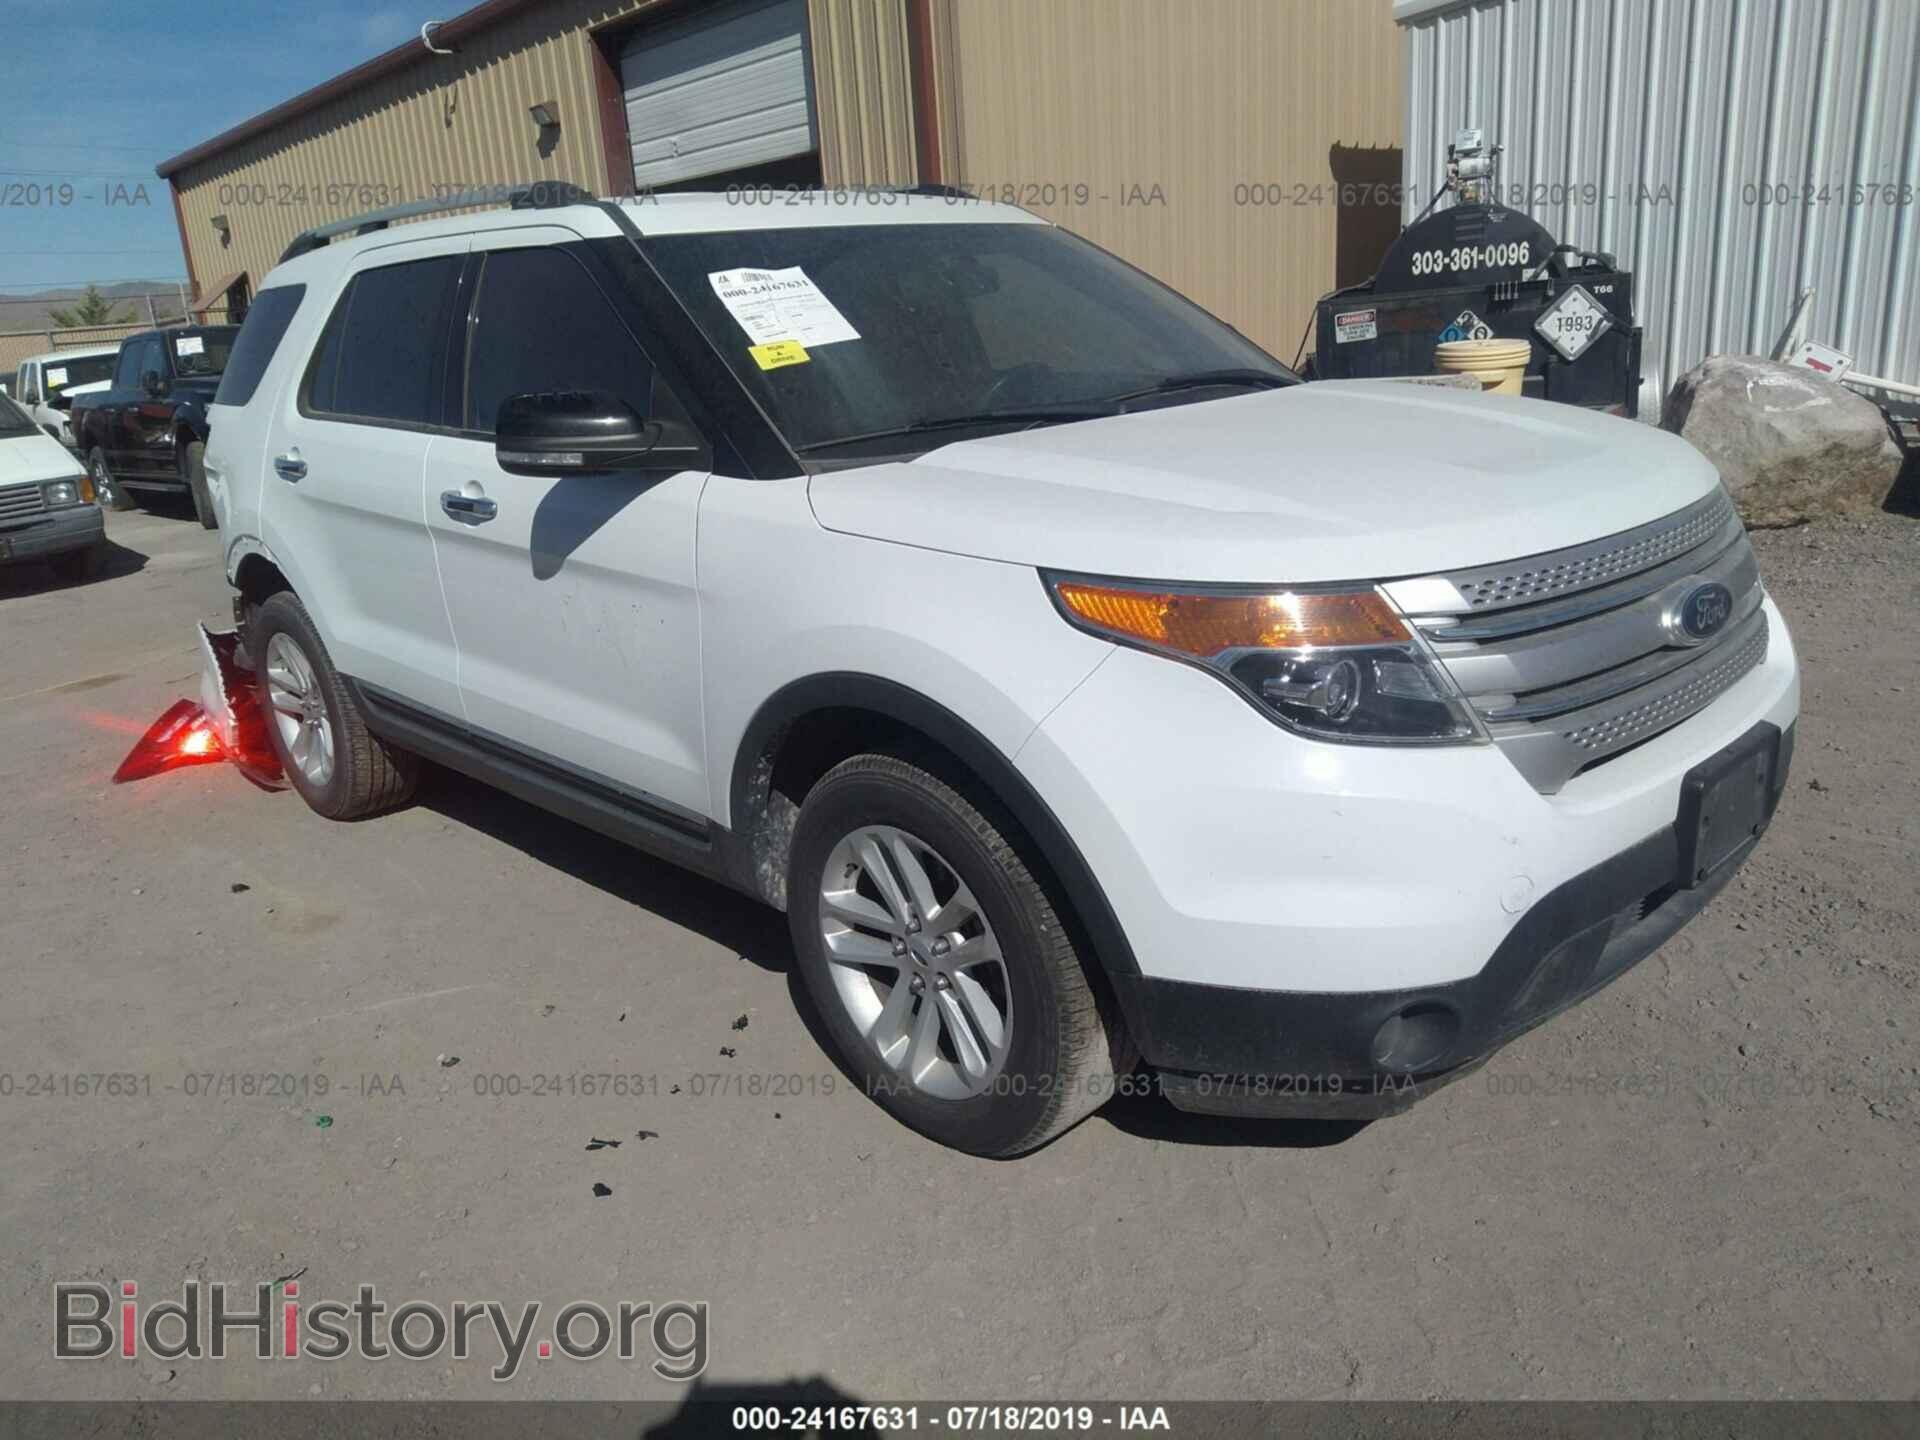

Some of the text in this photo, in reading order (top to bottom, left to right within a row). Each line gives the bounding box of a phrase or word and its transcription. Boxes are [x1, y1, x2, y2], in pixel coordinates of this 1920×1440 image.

[1411, 241, 1530, 276] 303-361-0096
[723, 279, 809, 298] 000-24167631
[1695, 590, 1729, 630] Ford
